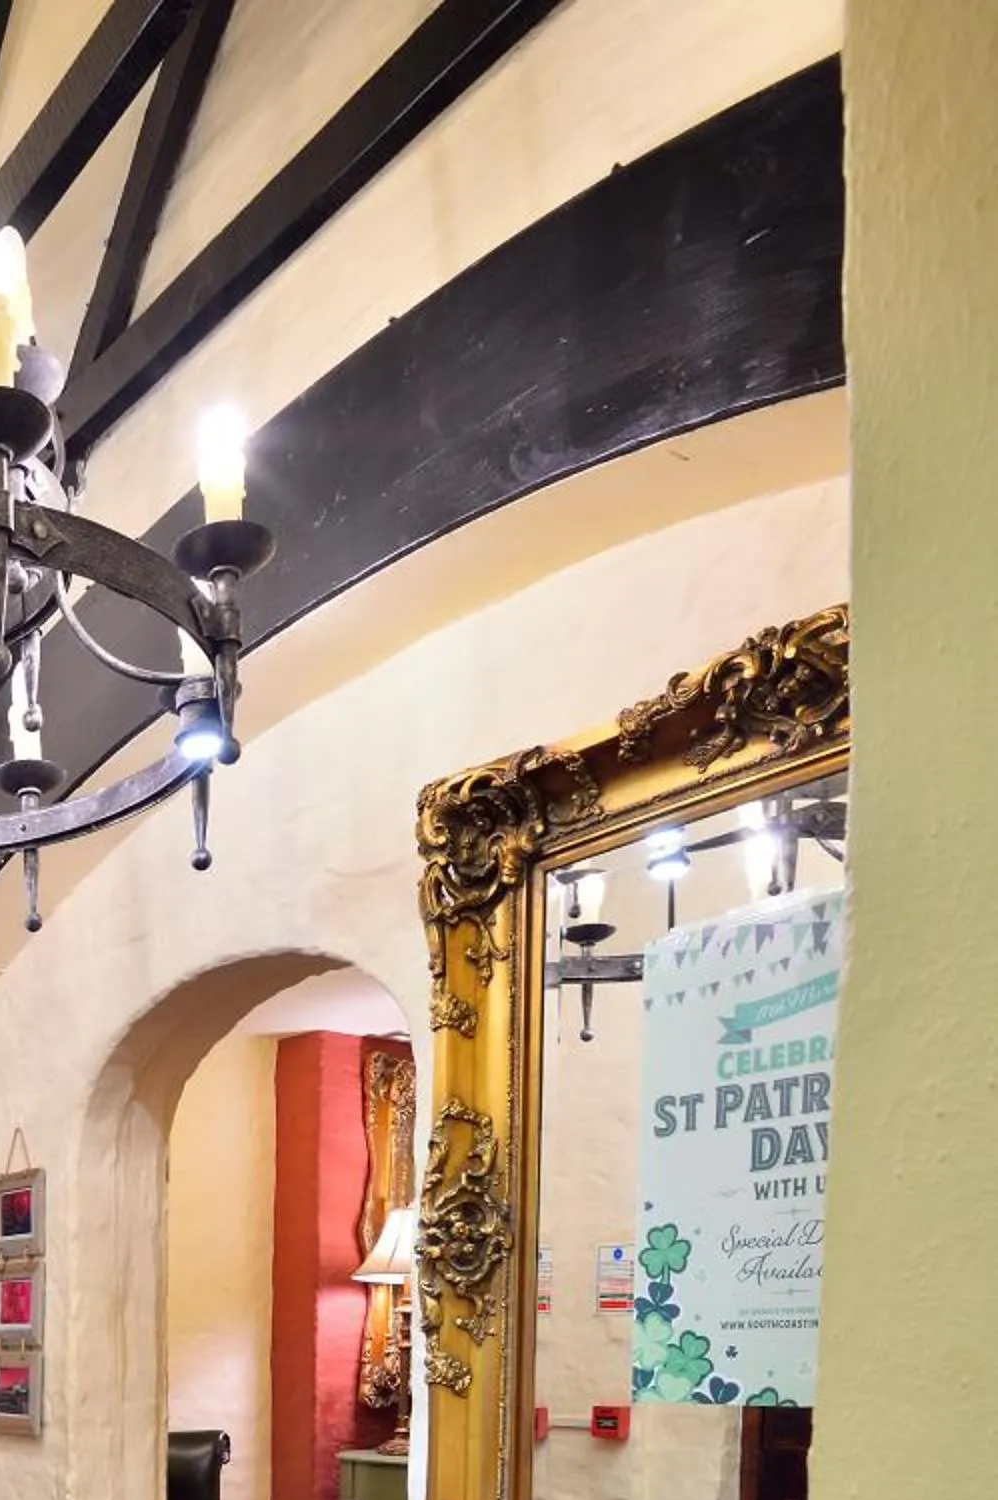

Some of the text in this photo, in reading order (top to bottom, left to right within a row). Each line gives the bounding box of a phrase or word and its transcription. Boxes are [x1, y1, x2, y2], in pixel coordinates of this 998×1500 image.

[717, 1035, 835, 1079] CELEBR
[654, 1072, 831, 1138] ST PATR
[754, 1177, 807, 1200] WITH
[721, 1221, 800, 1259] Special
